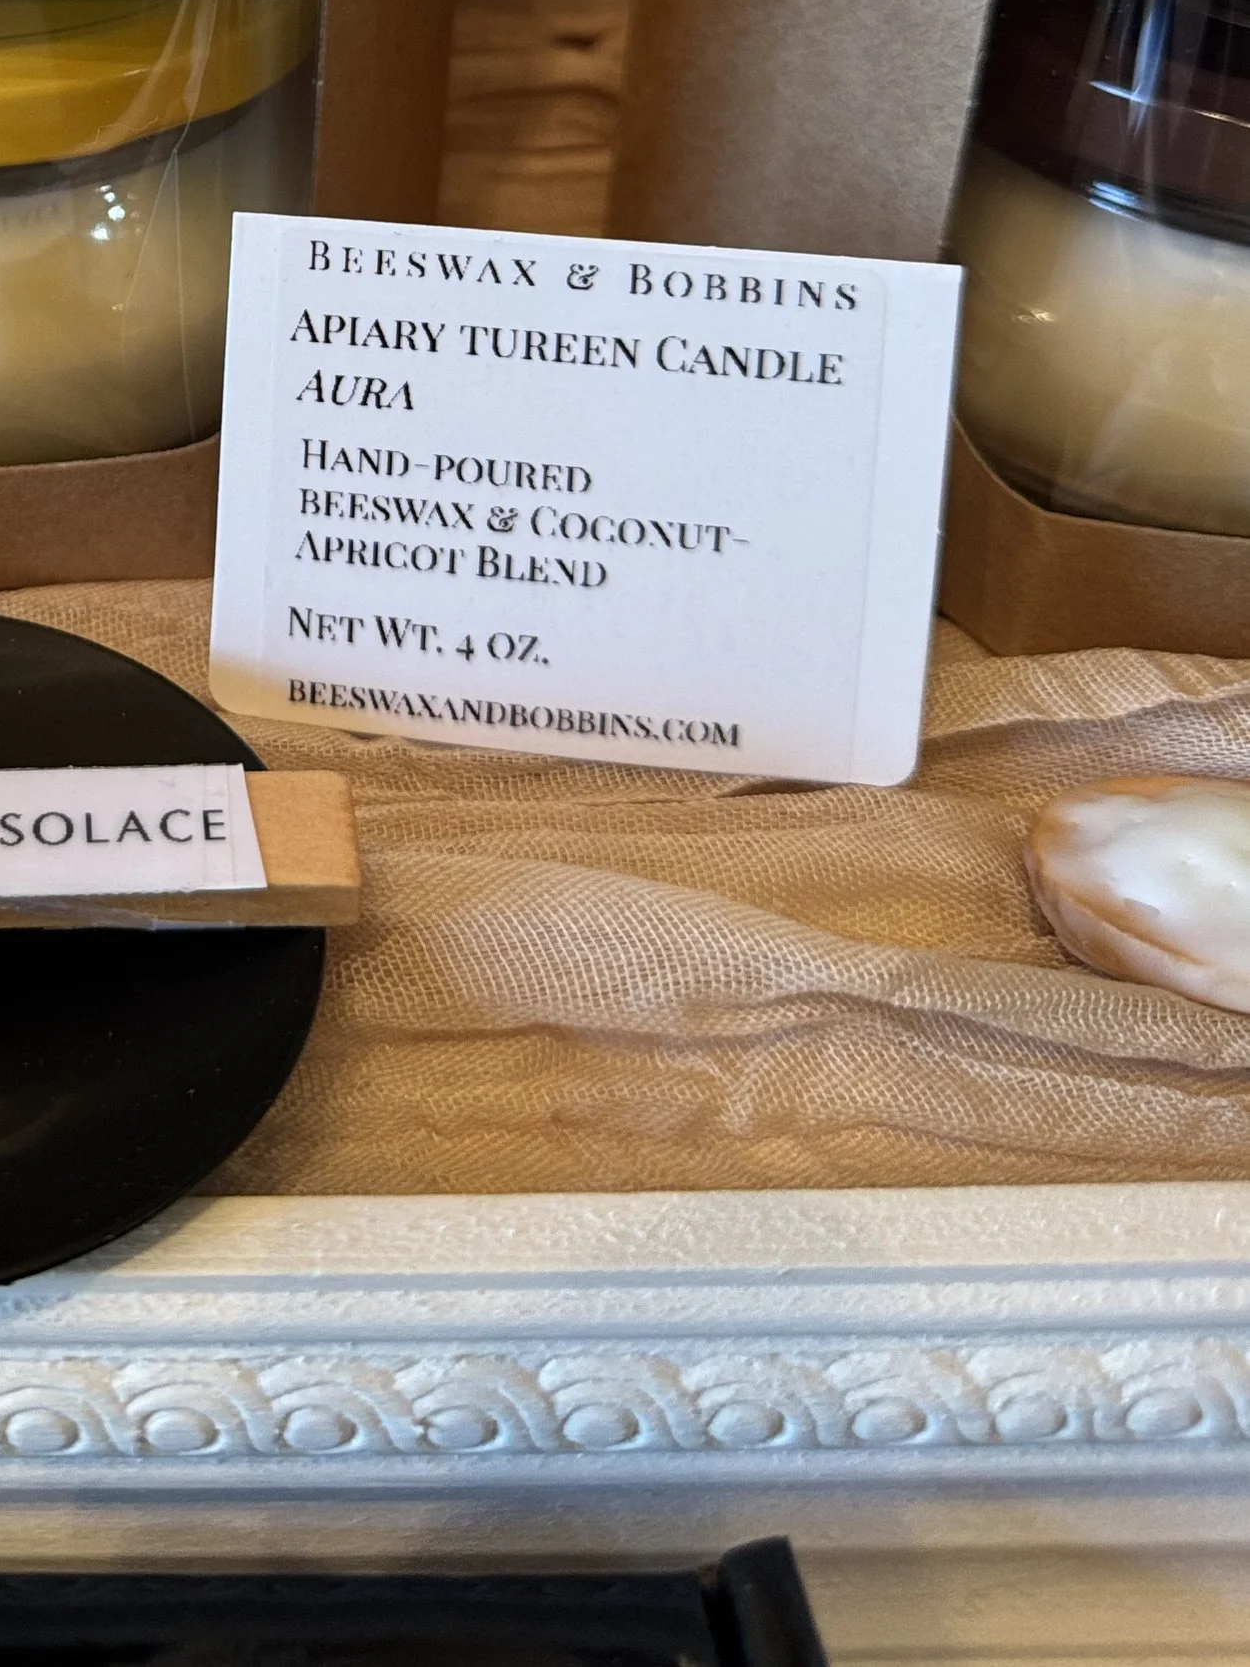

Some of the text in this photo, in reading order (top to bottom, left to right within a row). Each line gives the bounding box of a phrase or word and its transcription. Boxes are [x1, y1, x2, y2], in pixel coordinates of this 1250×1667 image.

[307, 239, 859, 312] BEESWAX & BOBBINS
[288, 308, 847, 387] APIARY TUREEN CANDLE
[294, 368, 415, 412] AURA
[300, 437, 594, 495] HAND-POURED
[298, 487, 476, 533] BEESWAX
[486, 505, 521, 535] &
[294, 529, 609, 590] APRICOT BLEND
[287, 605, 551, 667] NET WT. 4 OZ.
[287, 678, 742, 749] BEESWAXANDBOBBINS.COM
